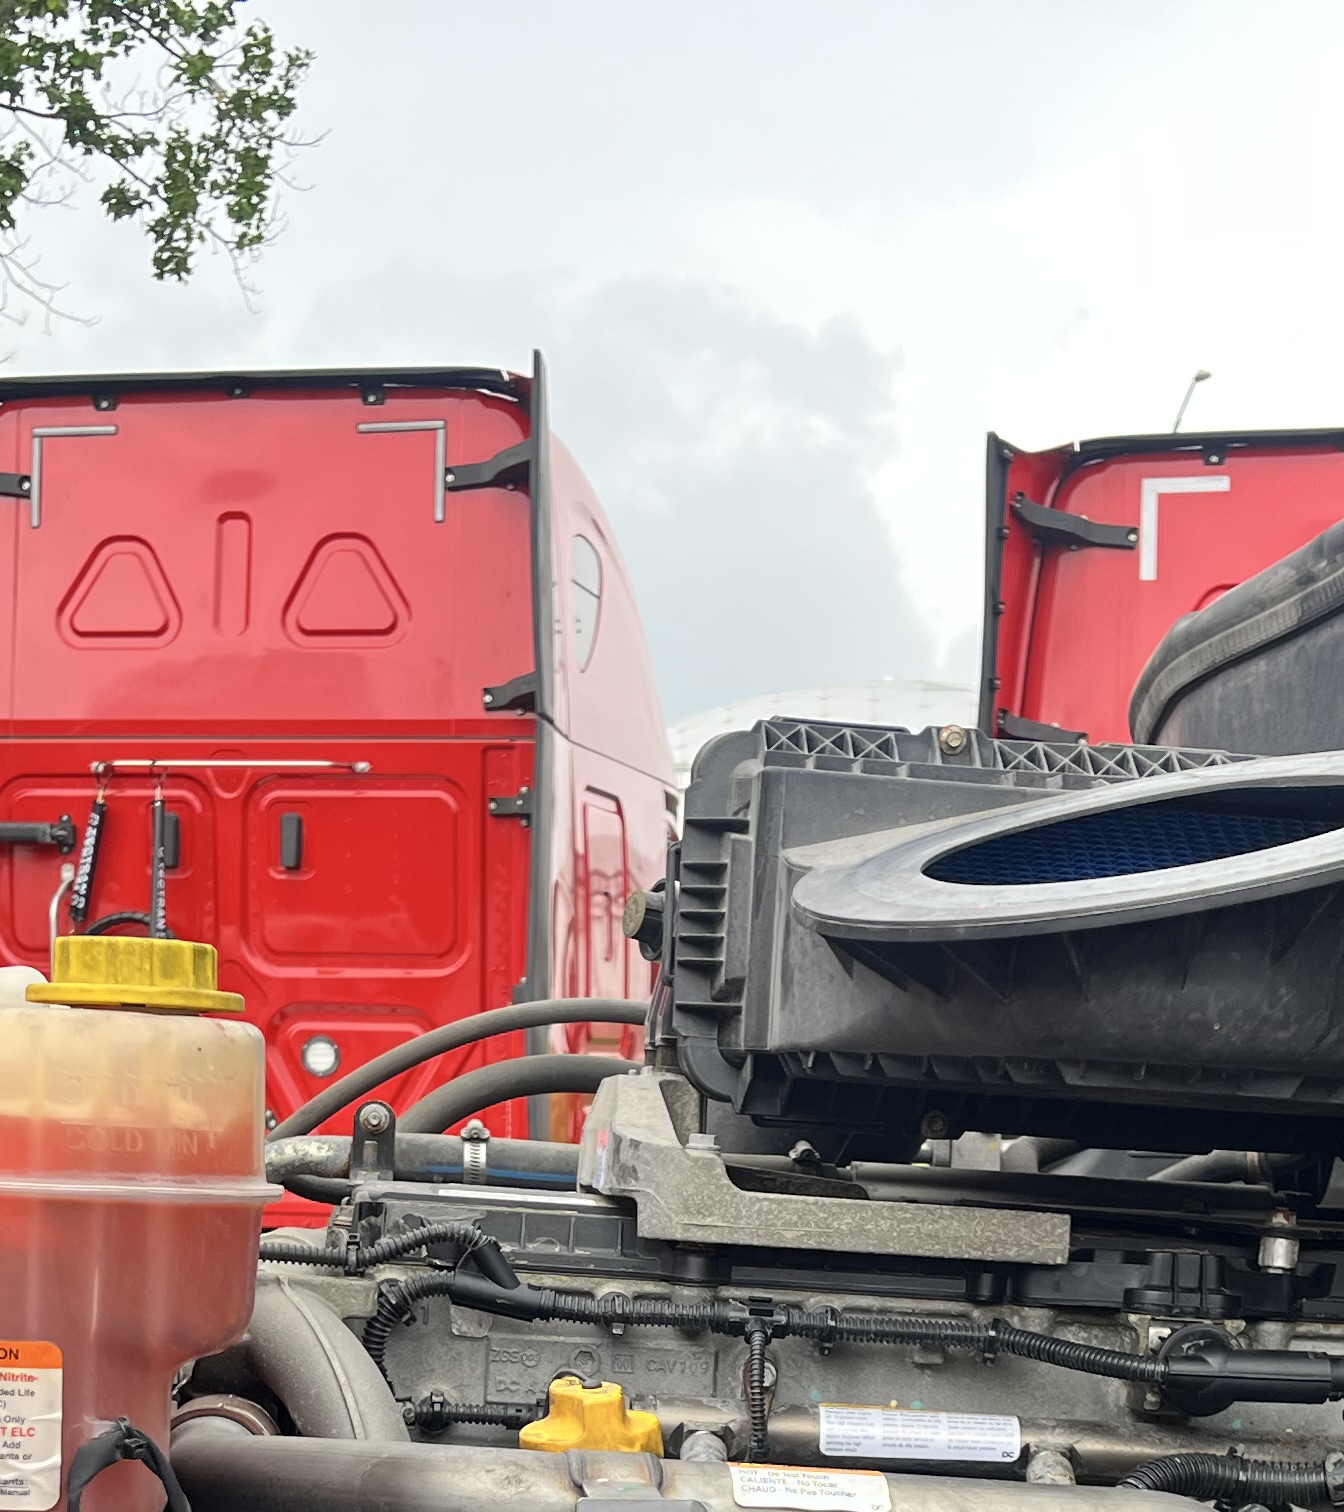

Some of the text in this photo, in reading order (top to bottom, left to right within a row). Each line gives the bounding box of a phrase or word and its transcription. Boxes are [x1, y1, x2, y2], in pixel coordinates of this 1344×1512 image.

[496, 1377, 520, 1393] DC
[17, 1388, 36, 1397] Life
[3, 1415, 26, 1425] Only
[10, 1427, 36, 1437] ELC
[2, 1440, 21, 1449] Add
[22, 1453, 33, 1461] or
[739, 1476, 788, 1486] CALIENTE
[819, 1489, 857, 1498] Toucher
